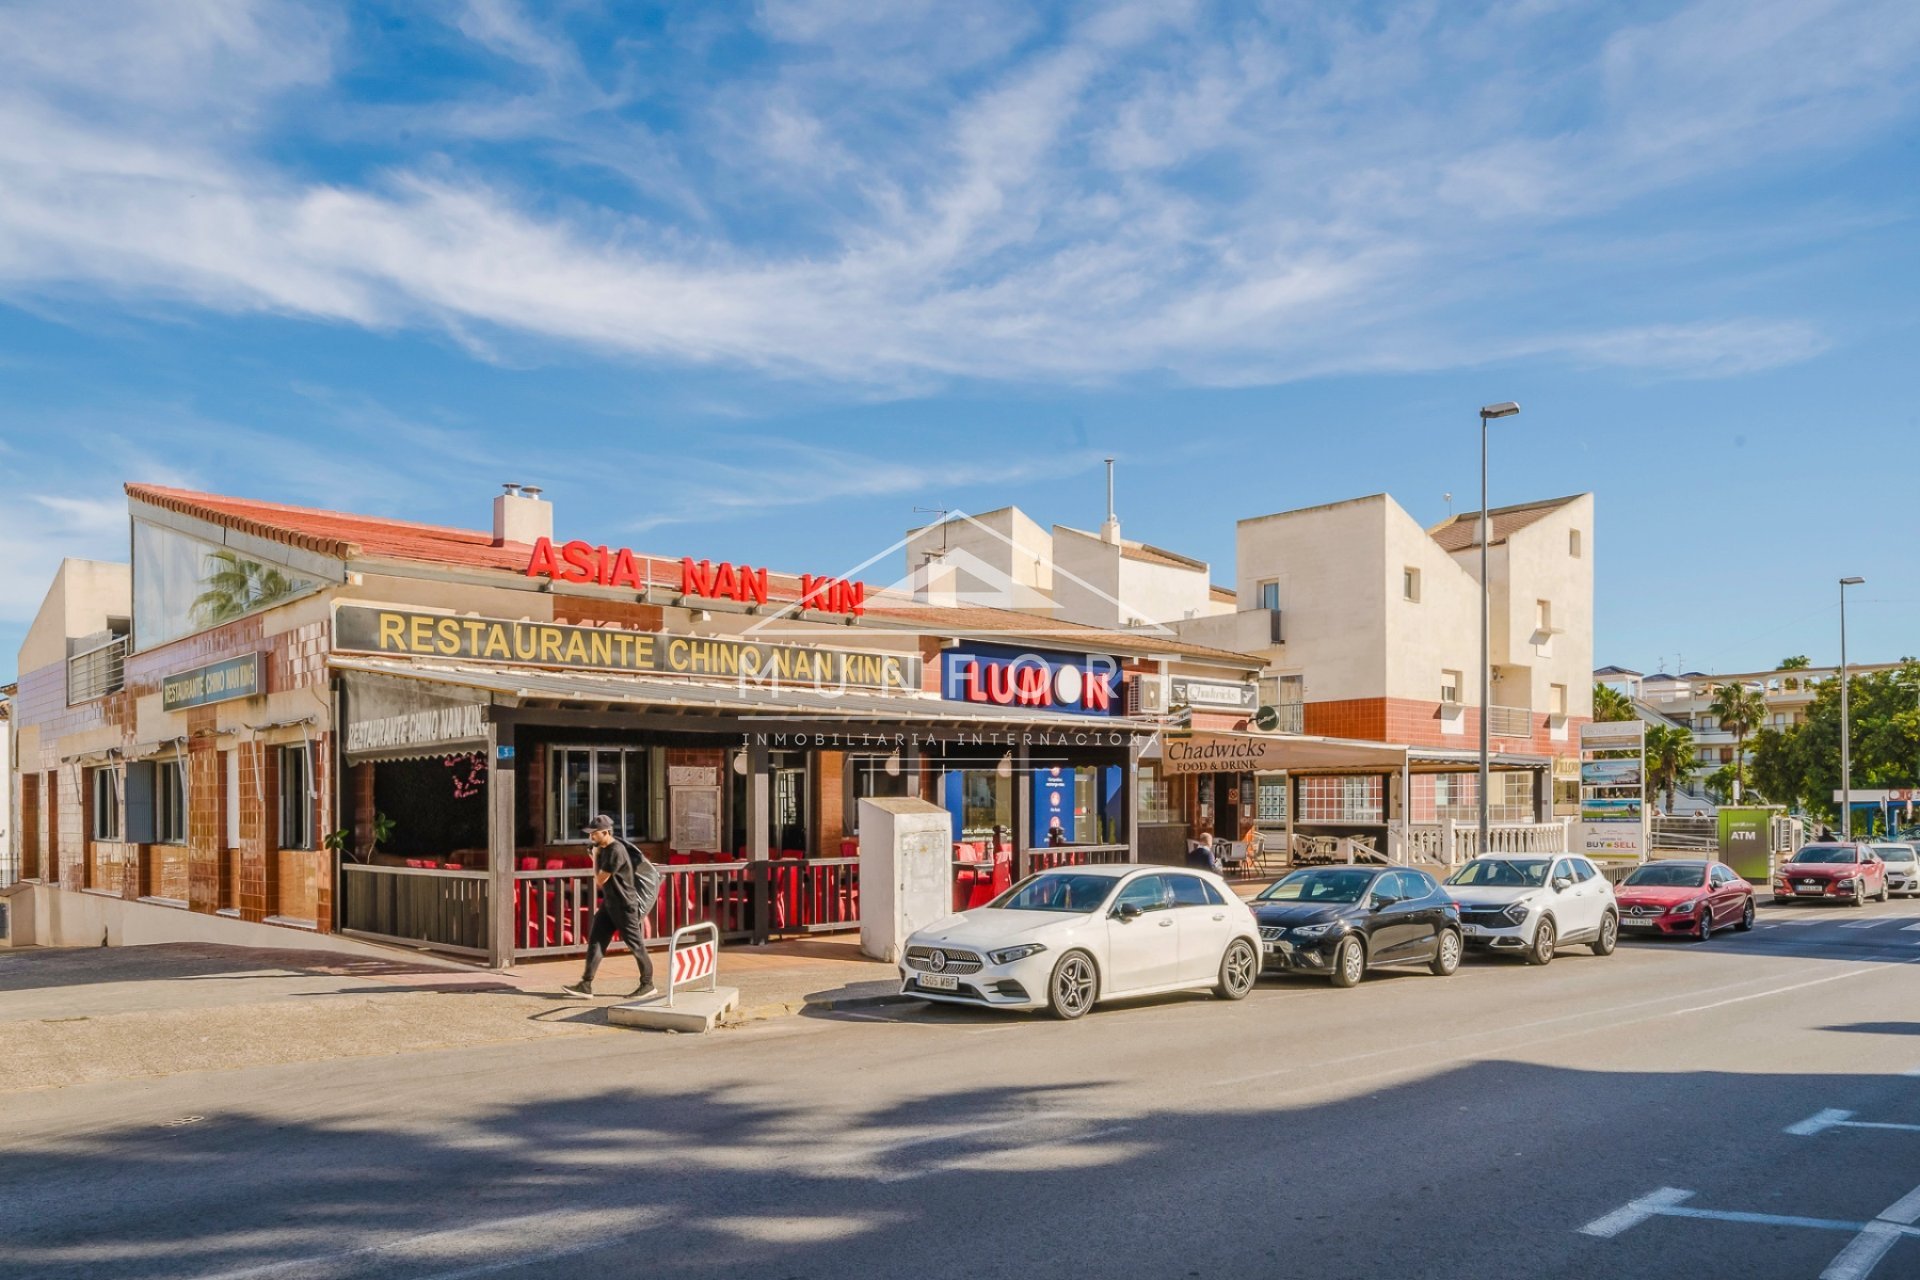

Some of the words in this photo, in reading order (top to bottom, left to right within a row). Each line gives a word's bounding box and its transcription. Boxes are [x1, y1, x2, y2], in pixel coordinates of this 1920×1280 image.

[526, 536, 643, 590] ASIA
[682, 556, 768, 605] NAN
[801, 573, 864, 616] KIN
[379, 612, 655, 668] RESTAURANTE
[669, 639, 761, 675] CHINO
[773, 649, 833, 681] NAN
[843, 654, 901, 685] KING
[966, 660, 1110, 710] LUMON
[348, 714, 408, 750] RESTAURANTE
[408, 709, 439, 743] CHINO
[441, 706, 462, 738] NAN
[1168, 738, 1266, 761] Chadwicks
[1177, 761, 1208, 772] FOOD
[1209, 761, 1218, 770] &
[1220, 759, 1258, 771] DRINK
[1613, 841, 1637, 849] SELL
[1730, 831, 1756, 841] ATM
